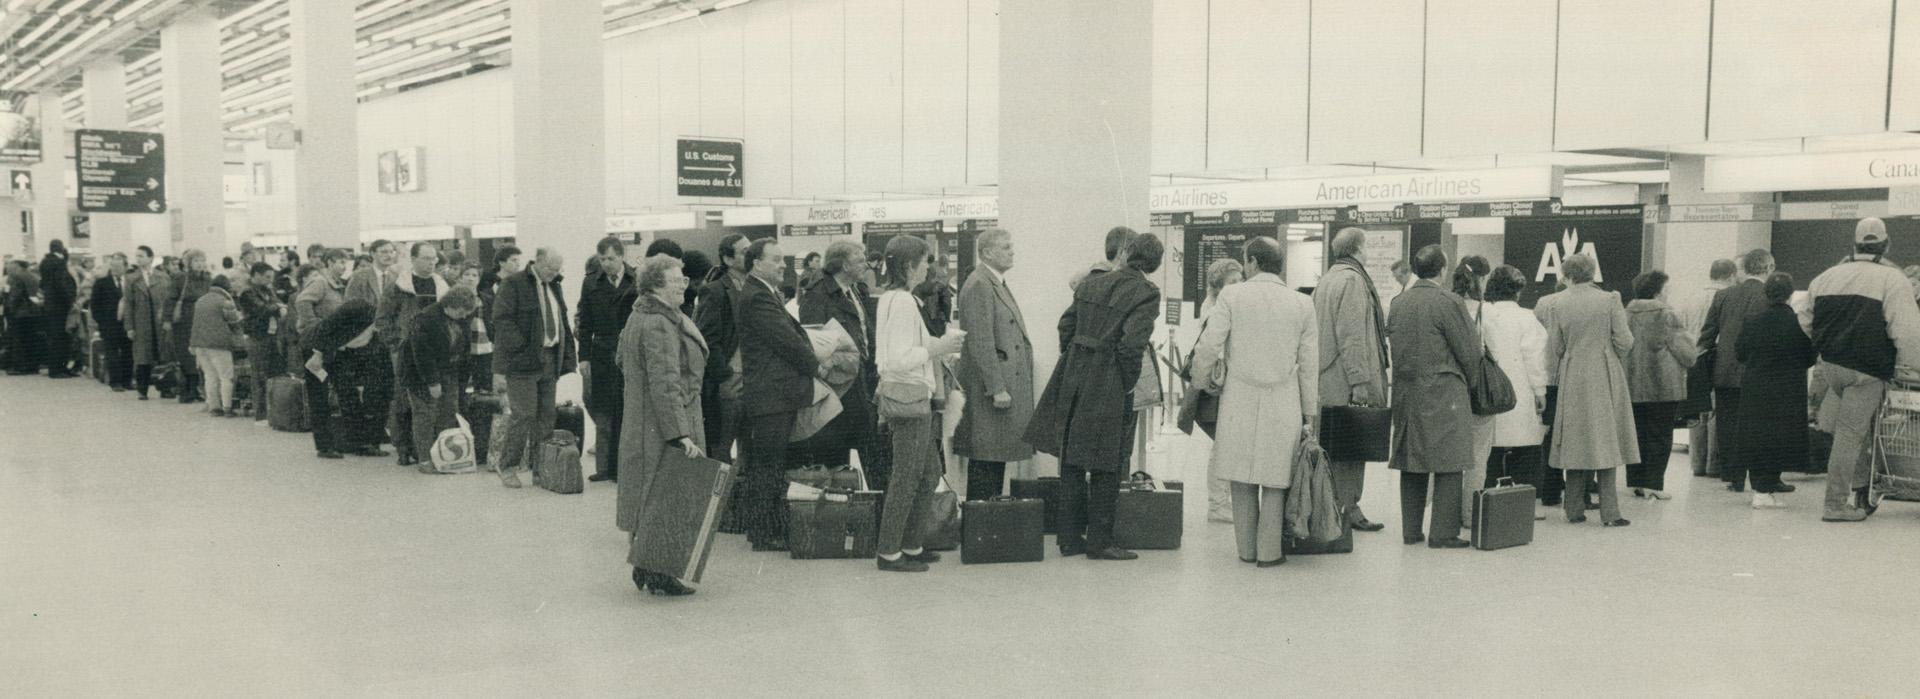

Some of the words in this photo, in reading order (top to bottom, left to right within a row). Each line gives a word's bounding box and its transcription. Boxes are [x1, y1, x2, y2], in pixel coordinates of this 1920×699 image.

[684, 151, 700, 160] U.S.
[702, 152, 735, 162] Customs
[1868, 158, 1920, 178] Cana
[678, 176, 711, 186] Douanes
[712, 178, 725, 187] des
[1315, 181, 1402, 201] American
[1407, 176, 1481, 196] Airlines
[1172, 188, 1228, 206] Airlines
[808, 206, 849, 221] American
[938, 200, 990, 218] American
[1395, 207, 1404, 218] 11
[1550, 202, 1561, 214] 12
[1223, 213, 1230, 223] 9
[1348, 209, 1357, 219] 10
[1646, 209, 1657, 219] 27
